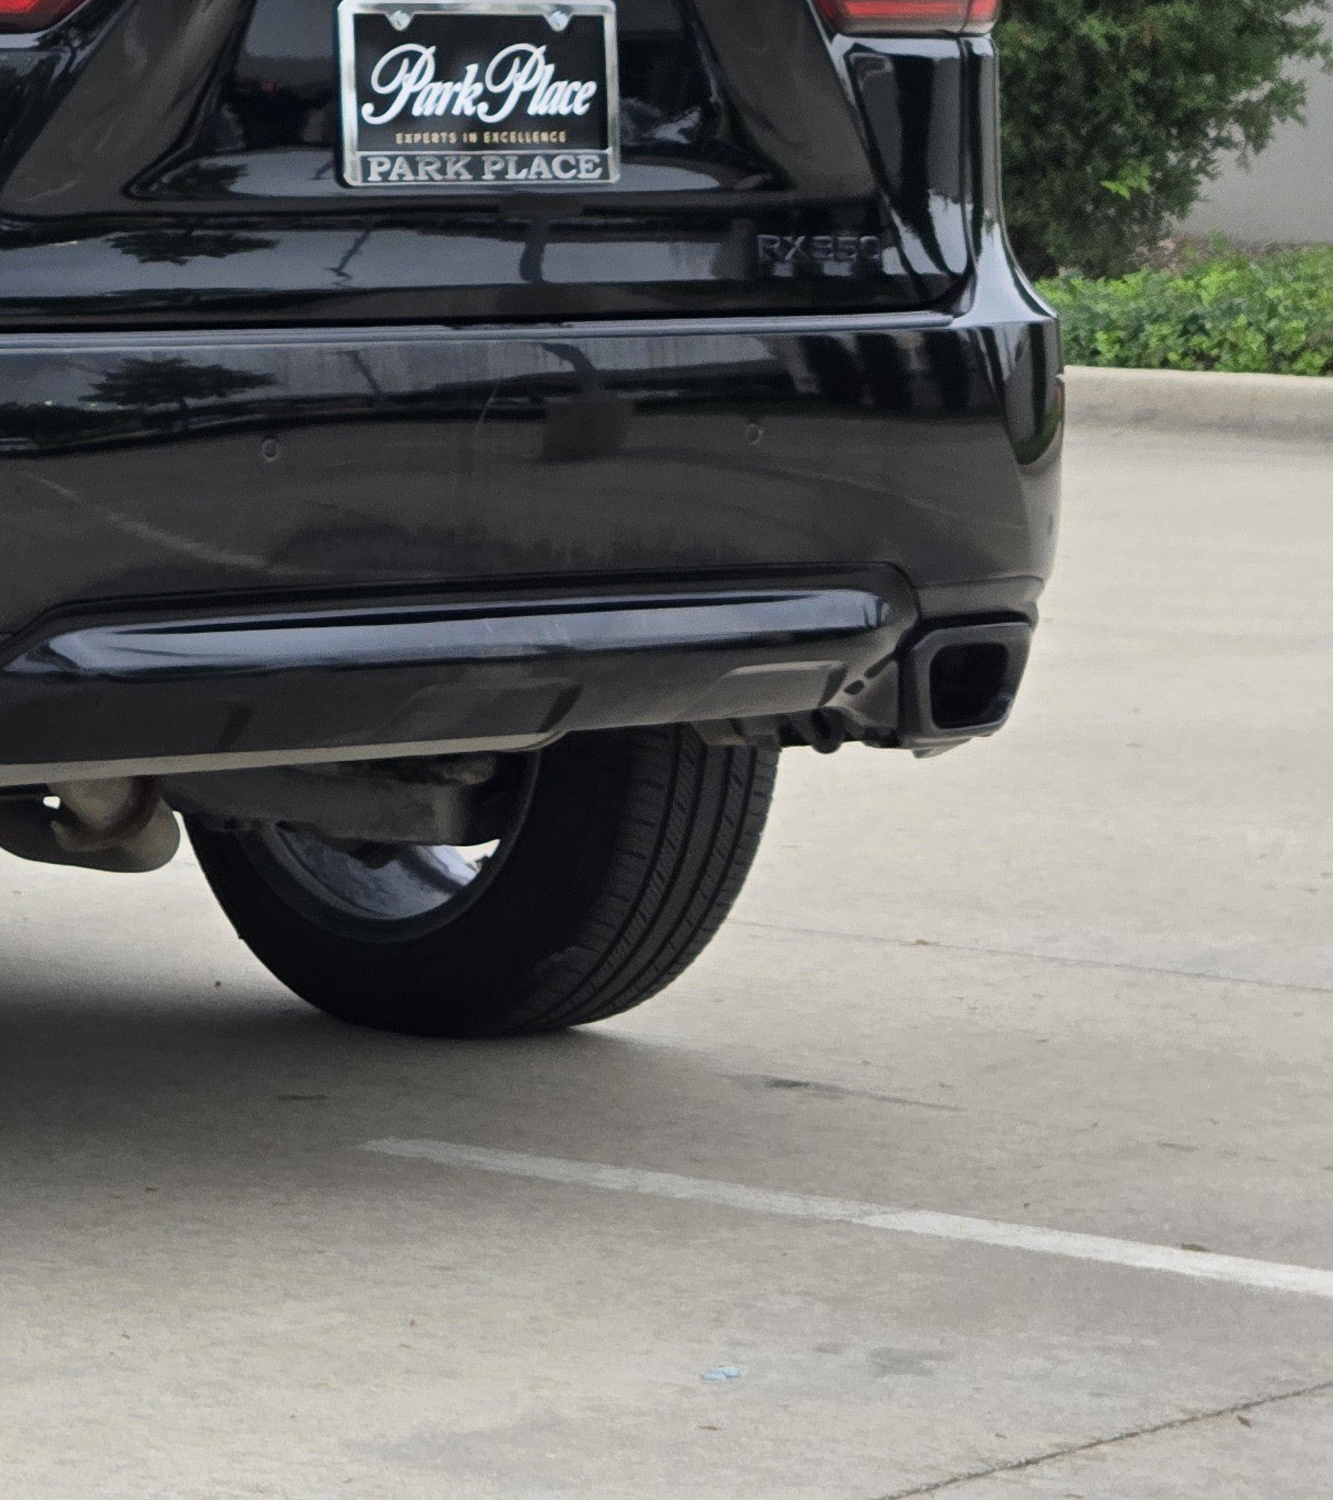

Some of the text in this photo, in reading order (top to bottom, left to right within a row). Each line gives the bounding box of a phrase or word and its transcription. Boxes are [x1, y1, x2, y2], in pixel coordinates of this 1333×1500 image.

[361, 42, 597, 125] Park Place
[395, 131, 567, 145] EXPERTS IN EXCELLENCE
[367, 154, 603, 182] PARK PLACE
